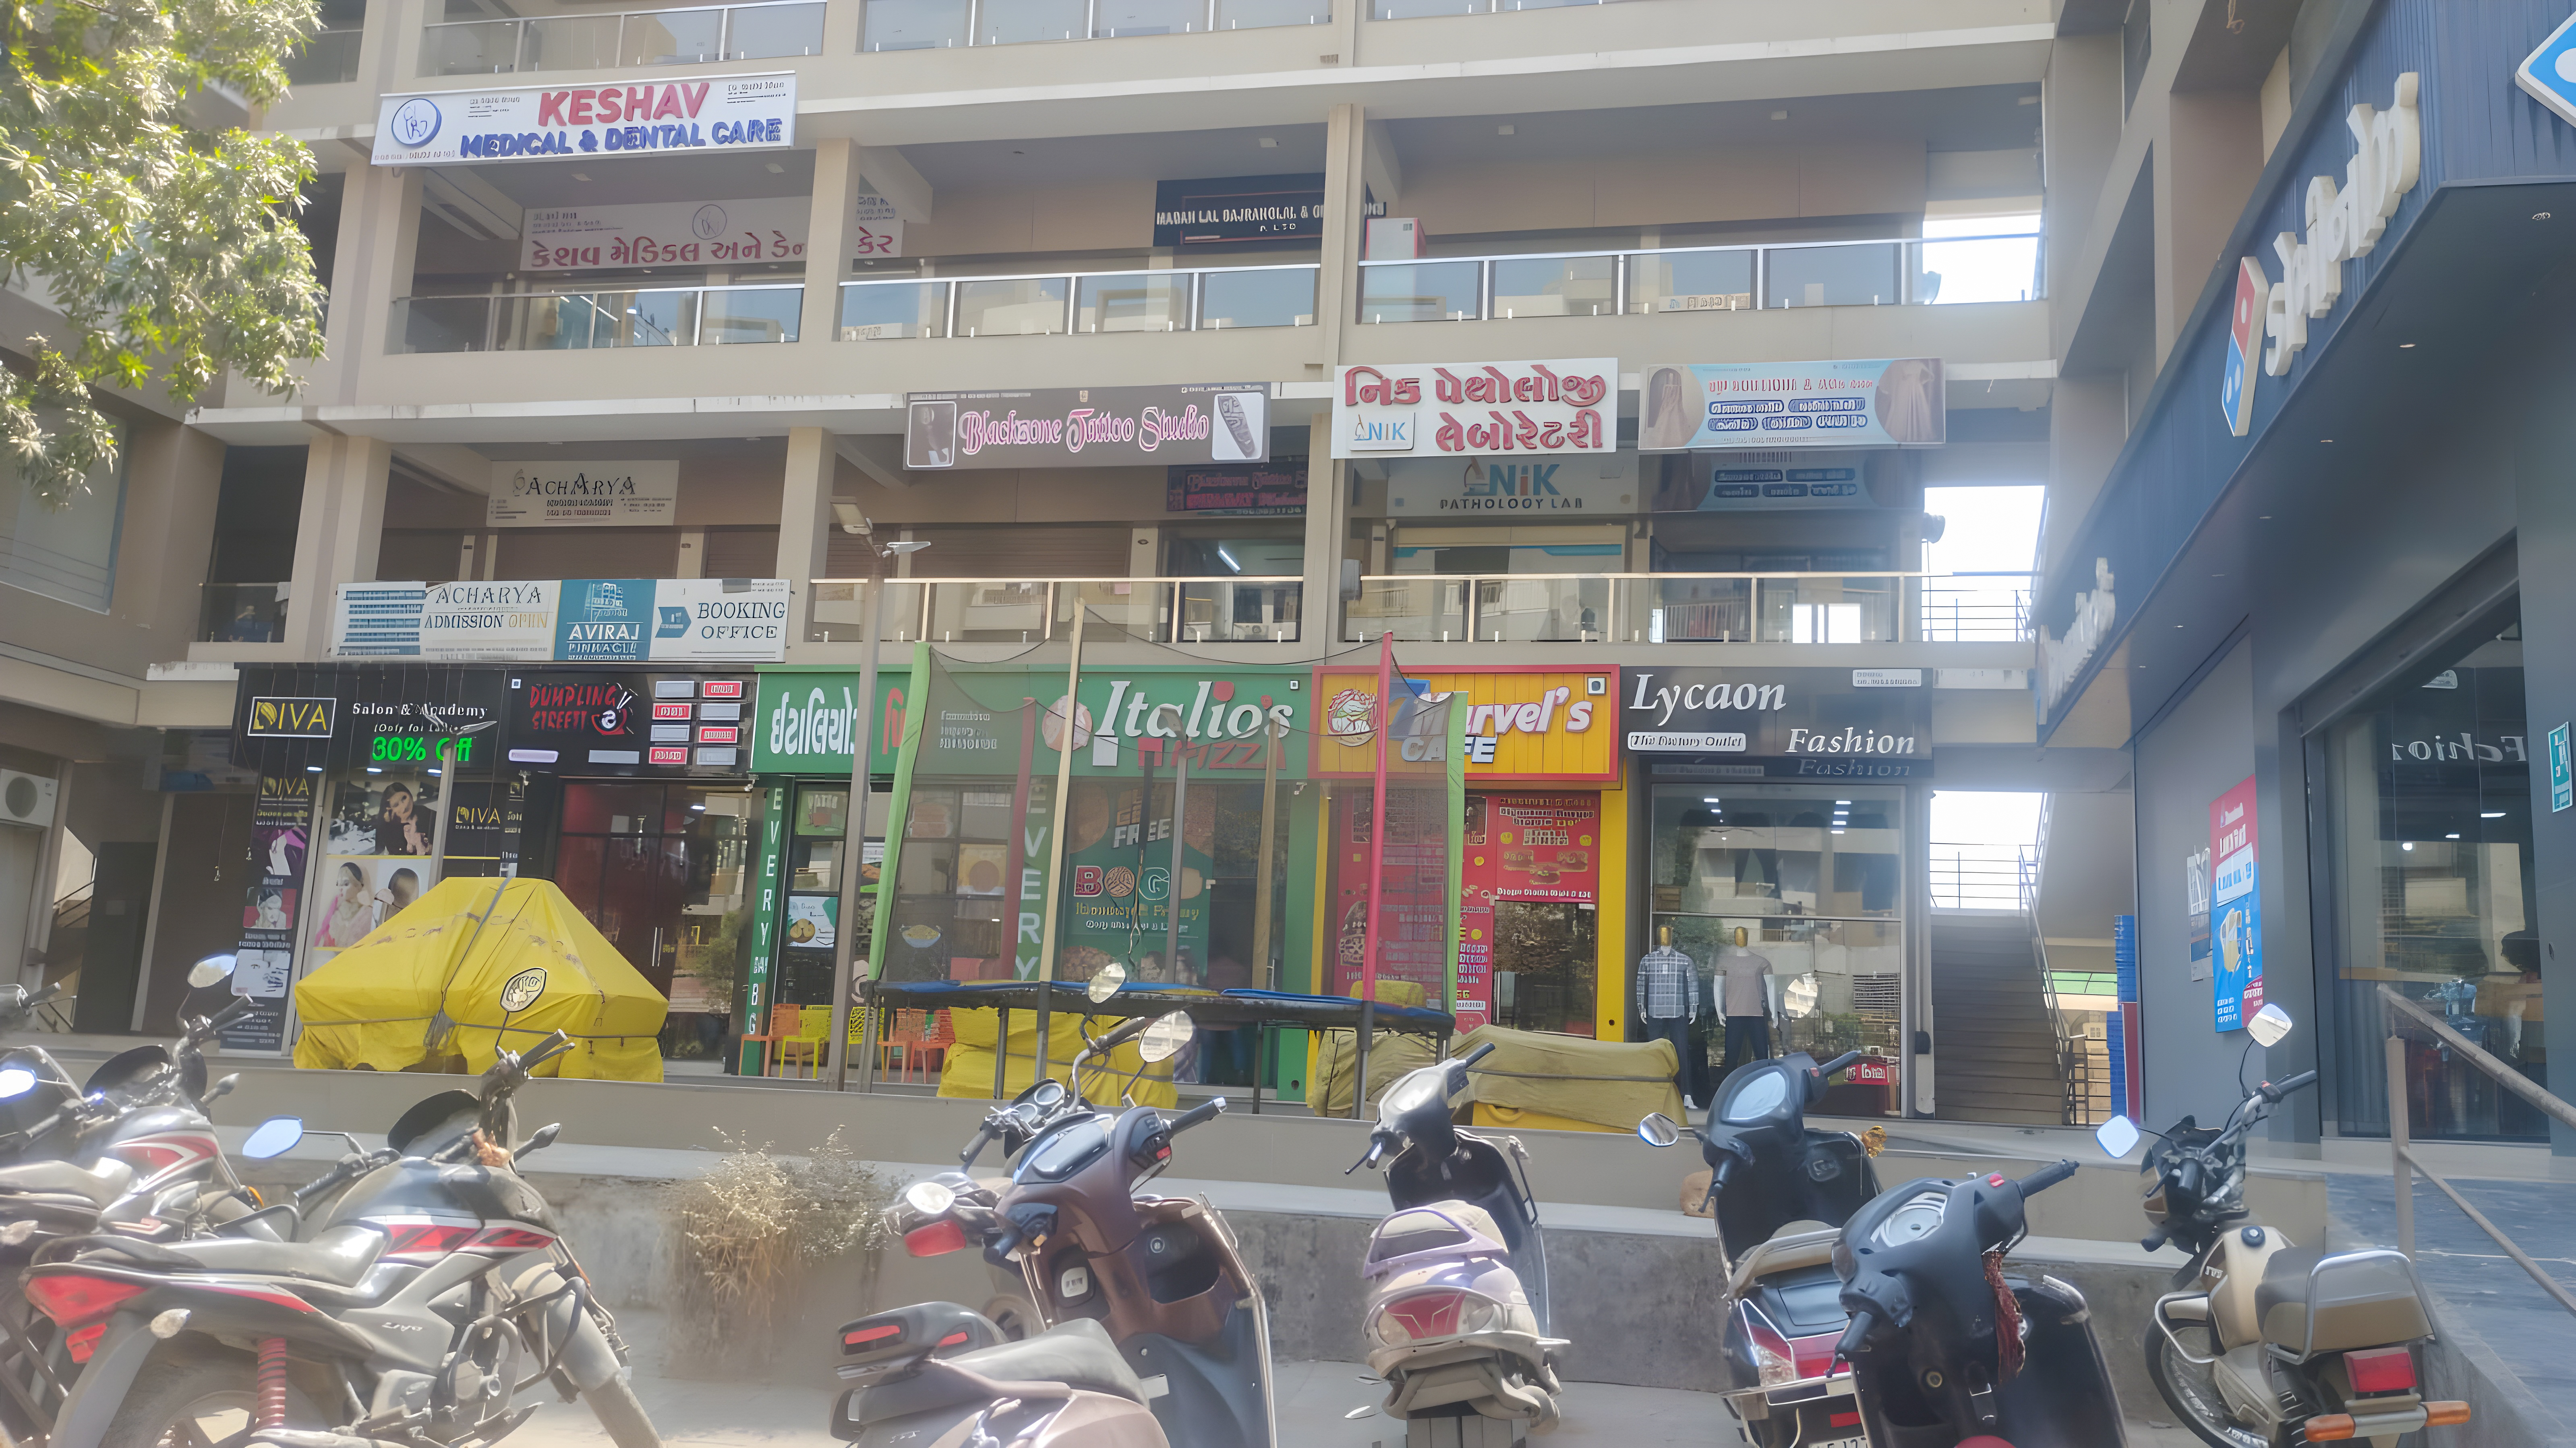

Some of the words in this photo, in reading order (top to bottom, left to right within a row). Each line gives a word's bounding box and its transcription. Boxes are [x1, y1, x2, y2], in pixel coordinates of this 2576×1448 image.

[538, 82, 710, 126] KESHAV
[461, 130, 573, 158] MEDICAL
[578, 129, 598, 152] &
[605, 122, 706, 151] DENTAL
[712, 118, 783, 144] CARE
[531, 240, 600, 267] કેશવ
[710, 232, 761, 260] અને
[857, 226, 893, 254] કેર
[1345, 365, 1422, 406] નિક
[1432, 364, 1607, 407] પેથોલોજી
[1066, 408, 1135, 453] Tattoo
[1139, 404, 1209, 452] Studio
[1435, 408, 1603, 451] લેબોરેટરી
[435, 581, 542, 604] ACHARYA
[424, 614, 503, 629] ADMISSION
[697, 602, 785, 619] BOOKING
[568, 624, 640, 641] AVIRAJ
[701, 625, 778, 639] OFFICE
[352, 703, 393, 715] Salon
[1094, 681, 1293, 738] Italio's
[1408, 685, 1594, 736] Mrvel's
[1629, 674, 1786, 726] Lycaon
[372, 736, 427, 762] 30%
[1785, 727, 1914, 754] Fashion
[1797, 758, 1910, 777] Fashion
